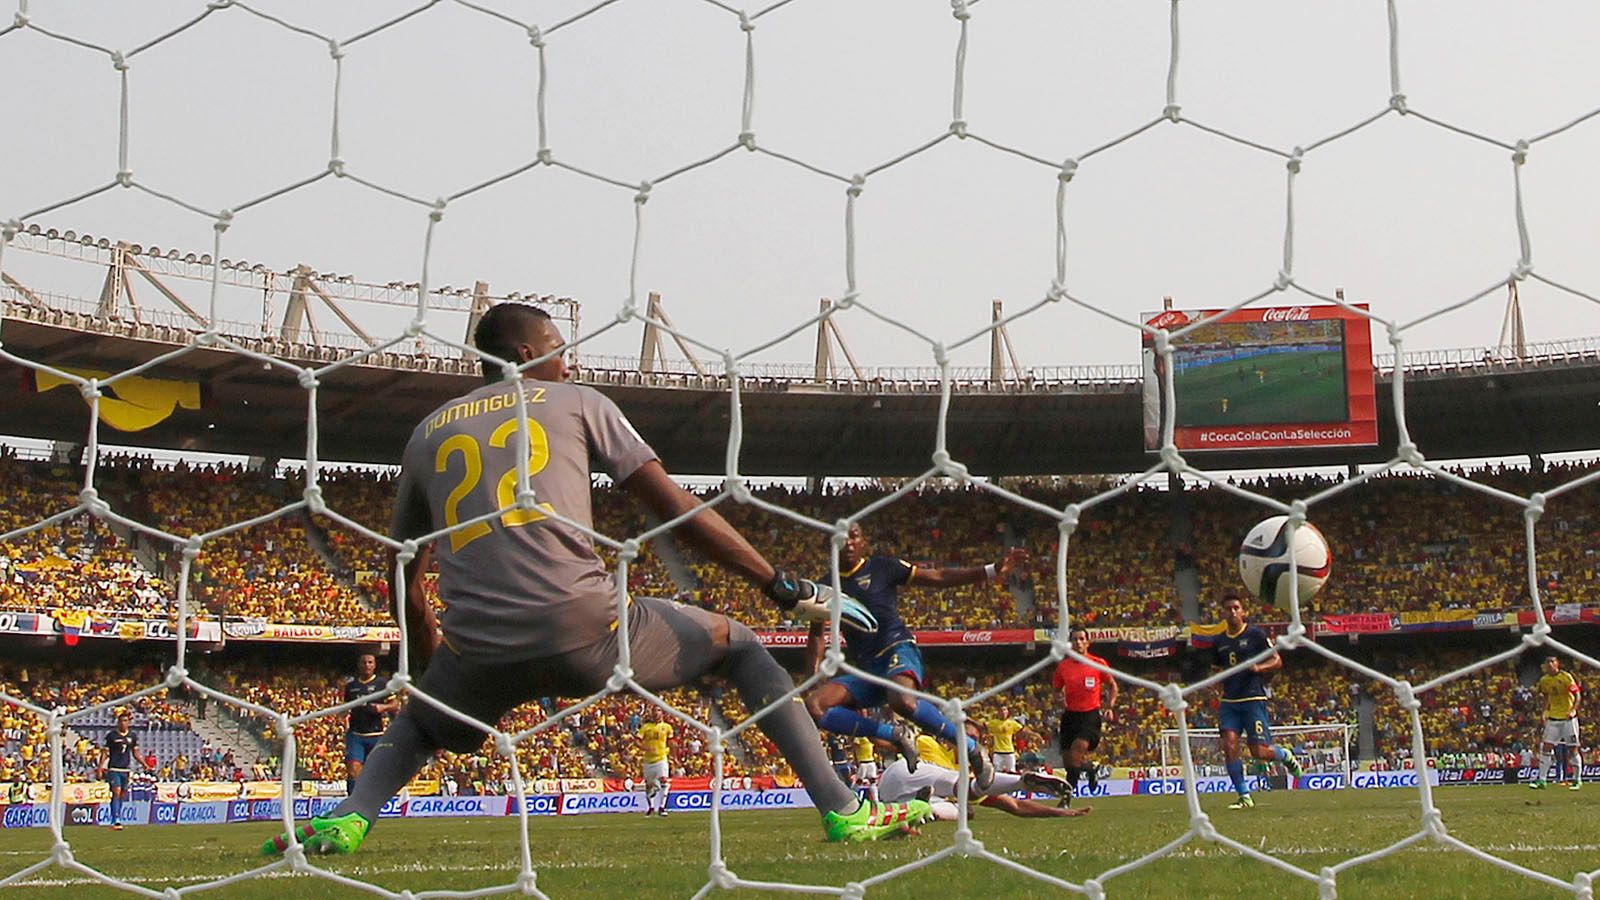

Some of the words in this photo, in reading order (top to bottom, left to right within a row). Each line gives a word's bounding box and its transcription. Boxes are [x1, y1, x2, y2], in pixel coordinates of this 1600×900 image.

[1263, 307, 1311, 321] Coca-Cola
[425, 387, 546, 440] DOMINGUEZ
[1200, 429, 1351, 442] #CocaColaConLaSelección
[435, 418, 555, 553] 22
[0, 614, 19, 631] OL
[775, 636, 796, 644] con
[1229, 652, 1237, 665] 6
[1474, 768, 1504, 782] plus
[1582, 764, 1600, 776] lus
[1148, 782, 1185, 794] GOL
[1308, 775, 1346, 789] GOL
[1355, 774, 1419, 788] CARACO
[381, 801, 401, 812] OL
[410, 800, 484, 812] CARACOL
[527, 799, 557, 811] GOL
[566, 796, 639, 809] CARACOL
[676, 794, 711, 807] GOL
[721, 793, 794, 805] CARACOL
[97, 806, 138, 822] CACOL
[157, 806, 175, 821] GOL
[180, 806, 216, 820] CARACOL
[234, 802, 249, 815] GOL
